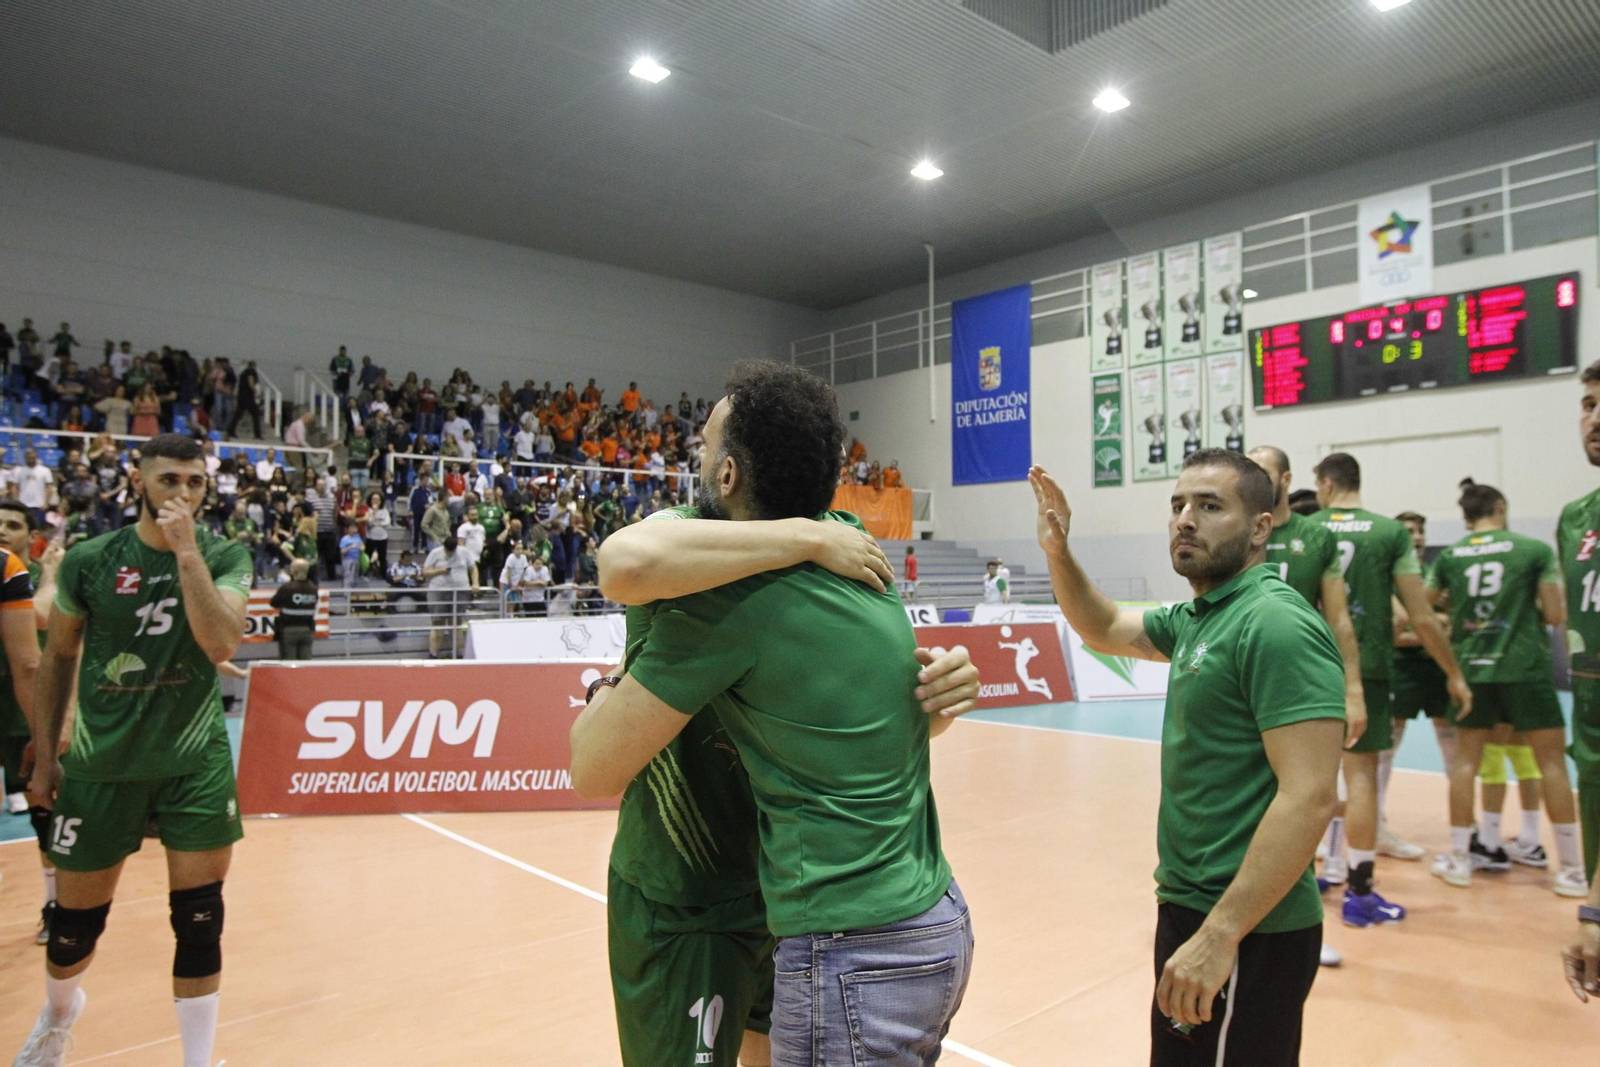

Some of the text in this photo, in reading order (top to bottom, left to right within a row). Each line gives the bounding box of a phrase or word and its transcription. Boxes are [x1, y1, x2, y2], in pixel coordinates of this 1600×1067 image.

[955, 391, 1028, 414] DIPUTACIÓN
[956, 406, 1026, 428] DE ALMERÍA
[1464, 562, 1505, 597] 13
[134, 597, 178, 636] 15
[977, 682, 1019, 698] ASCULINA
[297, 699, 501, 760] SVM
[288, 769, 574, 794] SUPERLIGA VOLEIBOL MASCULIN
[53, 814, 83, 847] 15
[688, 994, 724, 1051] 10
